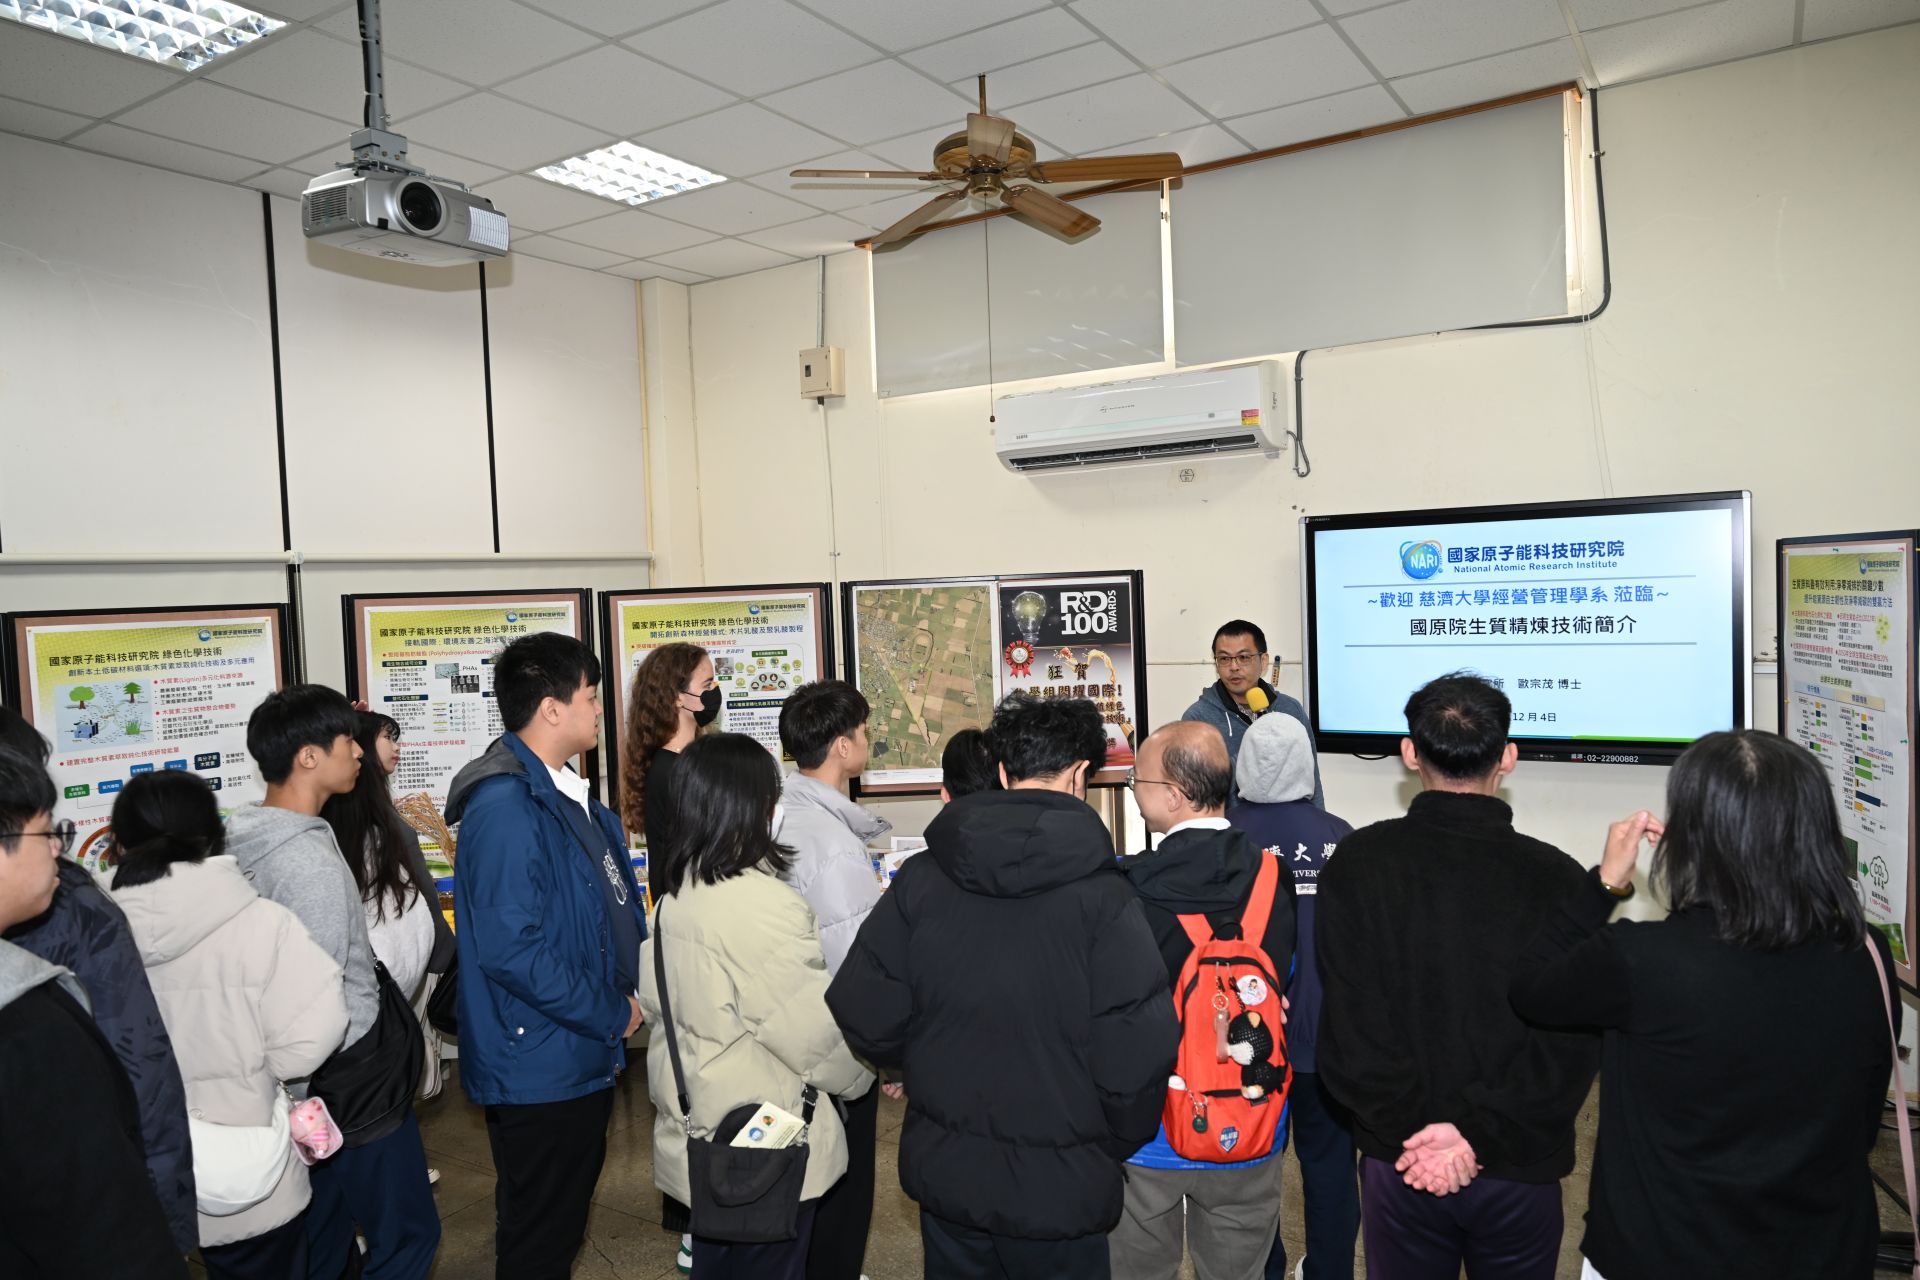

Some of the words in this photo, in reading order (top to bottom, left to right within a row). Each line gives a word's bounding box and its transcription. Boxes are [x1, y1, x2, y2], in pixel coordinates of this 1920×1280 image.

[1410, 553, 1438, 569] NARI
[1447, 540, 1625, 563] 國家原子能科技研究院
[1454, 564, 1491, 573] National
[1494, 563, 1526, 572] Atomic
[1529, 562, 1574, 571] Research
[1576, 560, 1618, 569] Institute
[1060, 590, 1108, 613] R&D
[1419, 585, 1608, 607] 慈濟大學經營管理學系
[1107, 590, 1118, 632] AWARDS
[379, 626, 471, 638] 國家原子能科技研究院
[473, 624, 527, 634] 綠色化學技術
[632, 618, 716, 630] 國家原子能科技研究院
[718, 616, 769, 627] 綠色化學技術
[1061, 612, 1109, 635] 100
[1410, 615, 1637, 636] 國原院生質精煉技術簡介
[49, 651, 159, 667] 國家原子能科技研究院
[162, 647, 222, 660] 綠色化學技術
[1557, 678, 1582, 690] 博士
[1512, 712, 1525, 721] 12
[1528, 712, 1537, 722] 月
[1540, 712, 1557, 722] 4日
